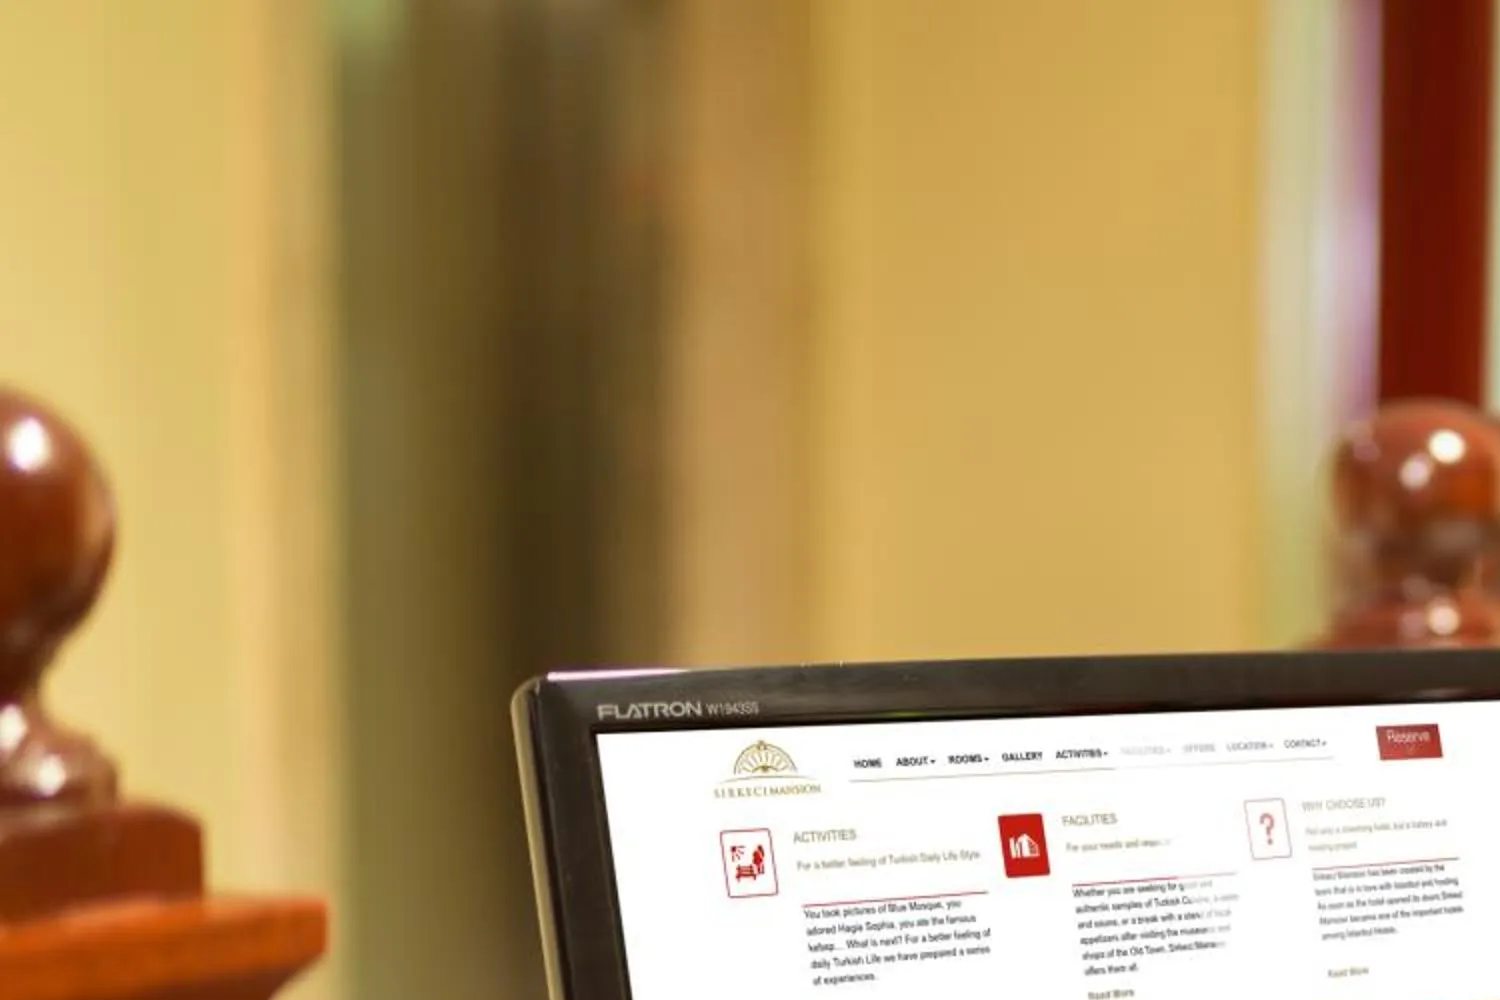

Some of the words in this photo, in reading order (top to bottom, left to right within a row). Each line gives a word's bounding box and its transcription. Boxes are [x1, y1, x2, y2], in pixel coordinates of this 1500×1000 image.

[597, 701, 702, 720] FLATRON
[1386, 727, 1430, 743] Reserve
[853, 757, 882, 768] HOME
[895, 755, 928, 767] ABOUT
[947, 753, 983, 764] ROOMS
[1001, 751, 1043, 762] GALLERY
[1055, 748, 1102, 759] ACTIVITIES
[1283, 737, 1321, 749] CONTACT
[1301, 800, 1323, 812] WHY
[1061, 812, 1118, 826] FACILITIES
[793, 828, 857, 844] ACTIVITIES
[796, 860, 811, 871] For
[898, 920, 915, 930] you
[845, 938, 868, 949] What
[904, 934, 919, 944] For
[1115, 948, 1128, 957] the
[810, 958, 831, 969] daily
[832, 955, 864, 967] Turkish
[865, 953, 882, 965] Life
[883, 954, 896, 962] we
[897, 952, 918, 961] have
[1087, 990, 1111, 1000] Read
